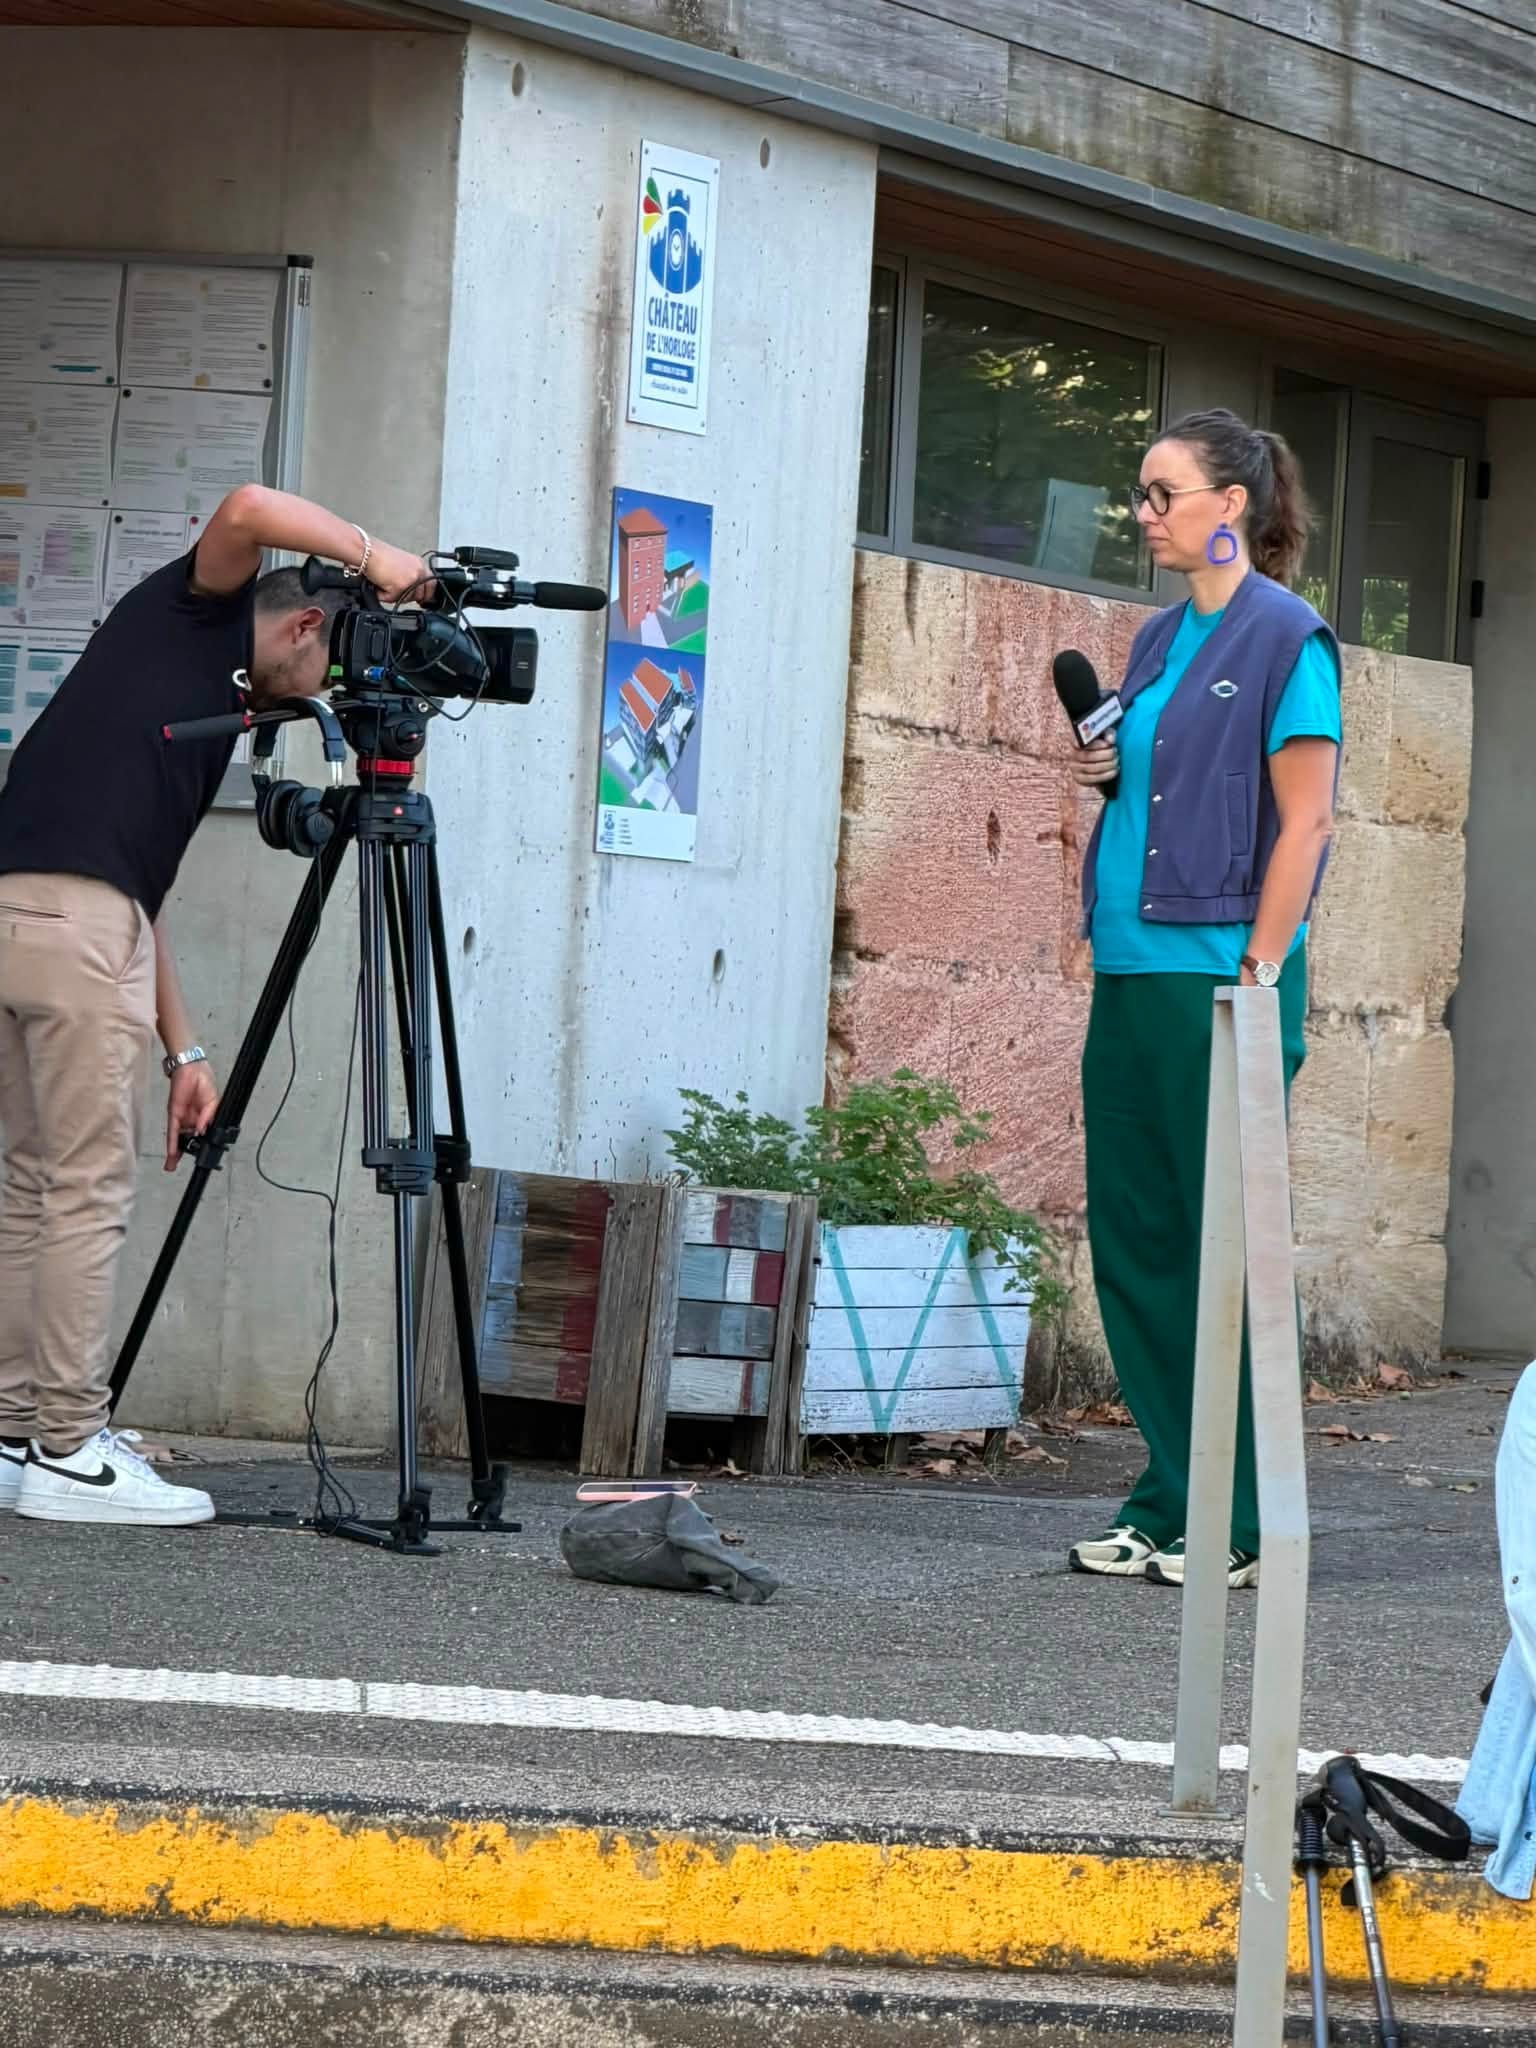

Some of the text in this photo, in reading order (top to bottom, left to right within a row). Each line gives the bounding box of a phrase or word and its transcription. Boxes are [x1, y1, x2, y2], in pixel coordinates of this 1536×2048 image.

[648, 292, 698, 335] CHÂTEAU
[646, 332, 695, 360] DE L'HORLOGE
